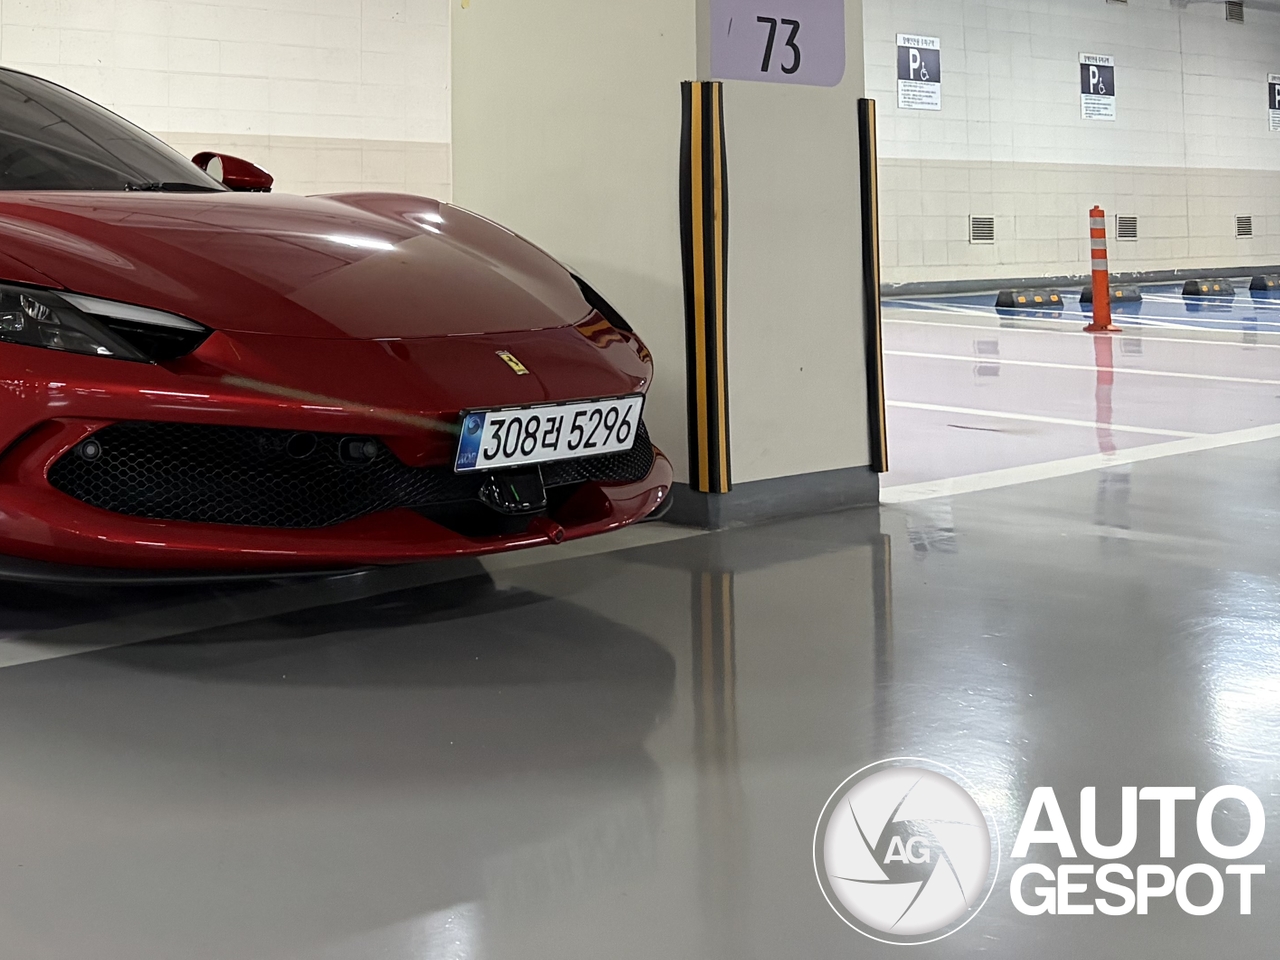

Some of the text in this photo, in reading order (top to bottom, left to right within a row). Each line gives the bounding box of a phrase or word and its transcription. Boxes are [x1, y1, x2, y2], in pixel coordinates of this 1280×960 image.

[756, 16, 801, 75] 73
[909, 48, 920, 80] P
[1089, 65, 1099, 93] P
[483, 404, 633, 461] 308러 5296
